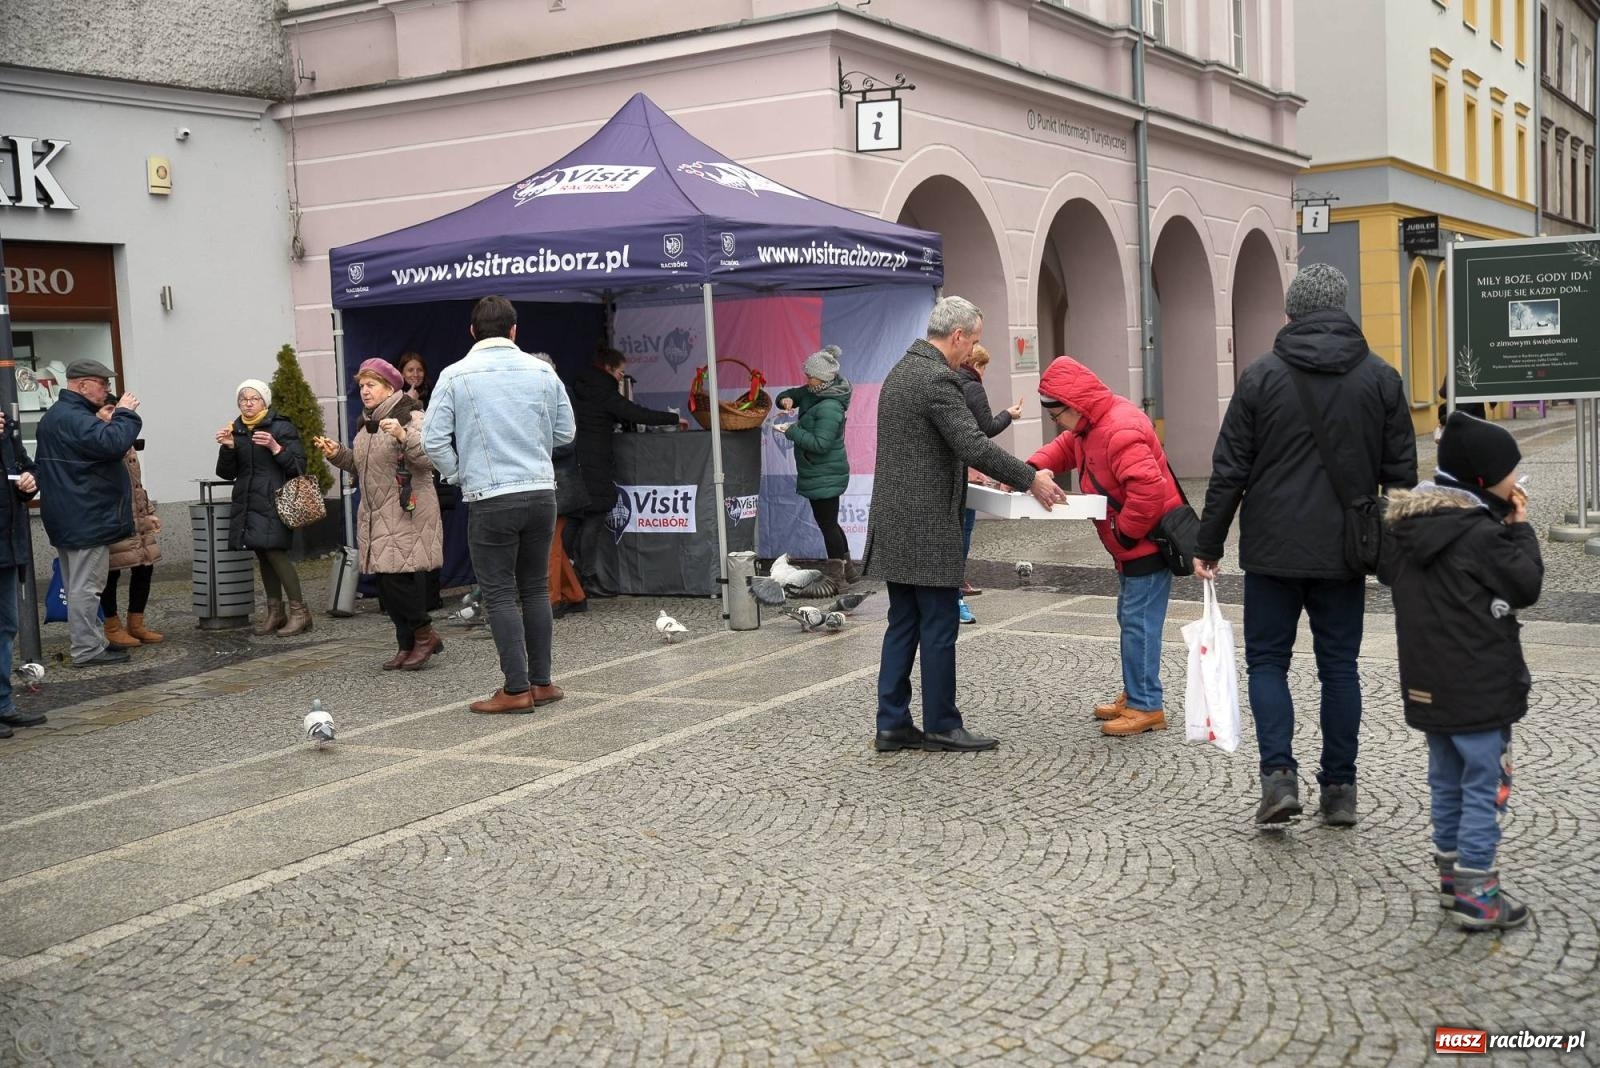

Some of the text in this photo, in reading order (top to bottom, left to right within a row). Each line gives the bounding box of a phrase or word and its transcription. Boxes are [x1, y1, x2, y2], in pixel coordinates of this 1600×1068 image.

[1037, 113, 1057, 134] Punkt
[1059, 120, 1090, 145] Informacji
[1091, 128, 1128, 154] Turystycznej
[0, 135, 80, 210] K
[567, 168, 640, 183] Visit
[391, 244, 630, 286] www.visitraciborz.pl
[757, 240, 909, 272] www.visitraciborz.pl
[1477, 276, 1501, 286] MIŁY
[1536, 272, 1567, 283] GODY
[1481, 289, 1512, 299] RADUJE
[1496, 338, 1532, 348] zimowym
[633, 489, 692, 514] Visit
[638, 515, 689, 528] RACIBÓRZ
